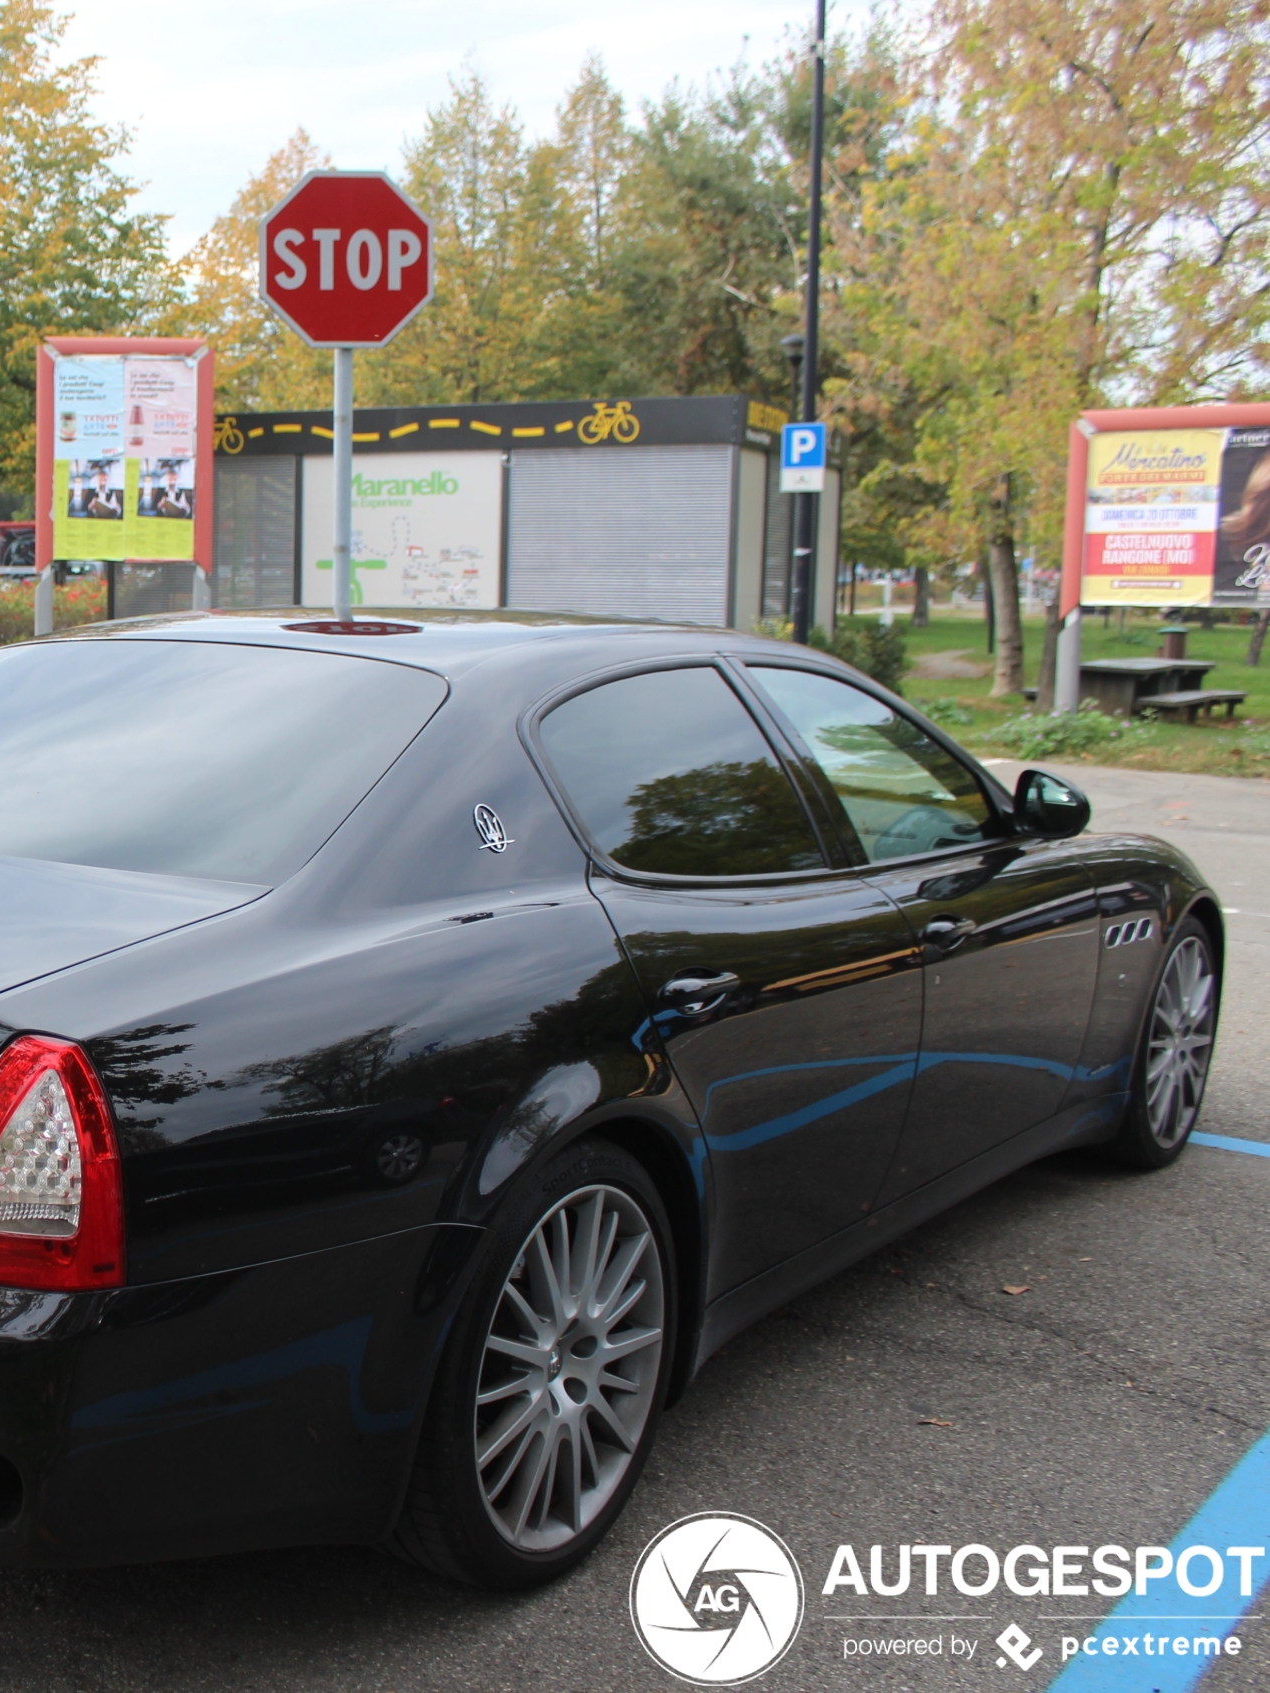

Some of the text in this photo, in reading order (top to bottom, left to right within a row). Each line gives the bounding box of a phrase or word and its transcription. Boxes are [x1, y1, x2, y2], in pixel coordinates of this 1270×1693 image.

[273, 228, 422, 291] STOP
[790, 429, 817, 465] P
[1101, 442, 1207, 473] Mercatino
[1100, 474, 1136, 483] FORTE
[1103, 509, 1145, 520] DOMENICA
[1159, 509, 1197, 520] OTTOBRE
[1105, 533, 1192, 550] CASTELNUOVO
[1102, 549, 1162, 565] RANGONE
